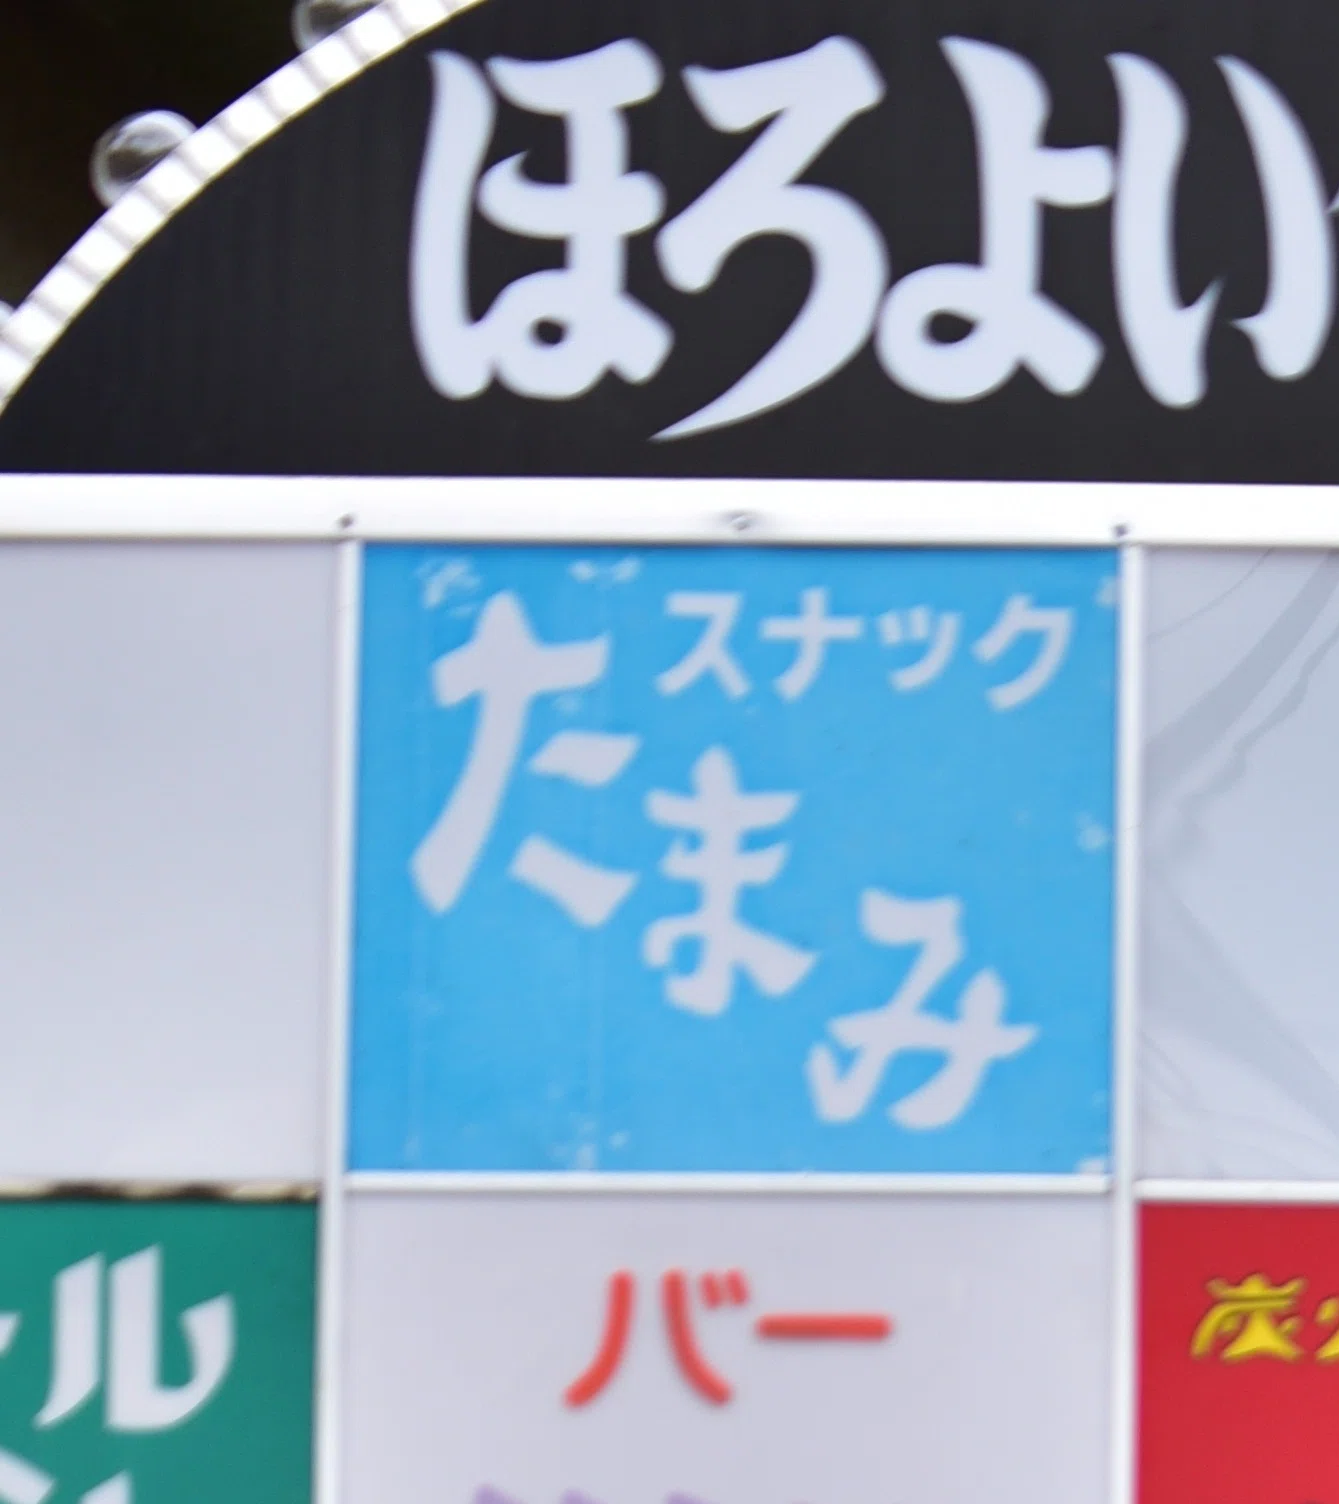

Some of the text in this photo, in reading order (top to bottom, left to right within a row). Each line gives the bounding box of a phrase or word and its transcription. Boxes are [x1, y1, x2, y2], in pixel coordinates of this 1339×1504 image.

[656, 588, 1072, 710] スナック
[411, 588, 1040, 1131] たまみ
[0, 1243, 236, 1432] ル
[563, 1269, 893, 1409] バー
